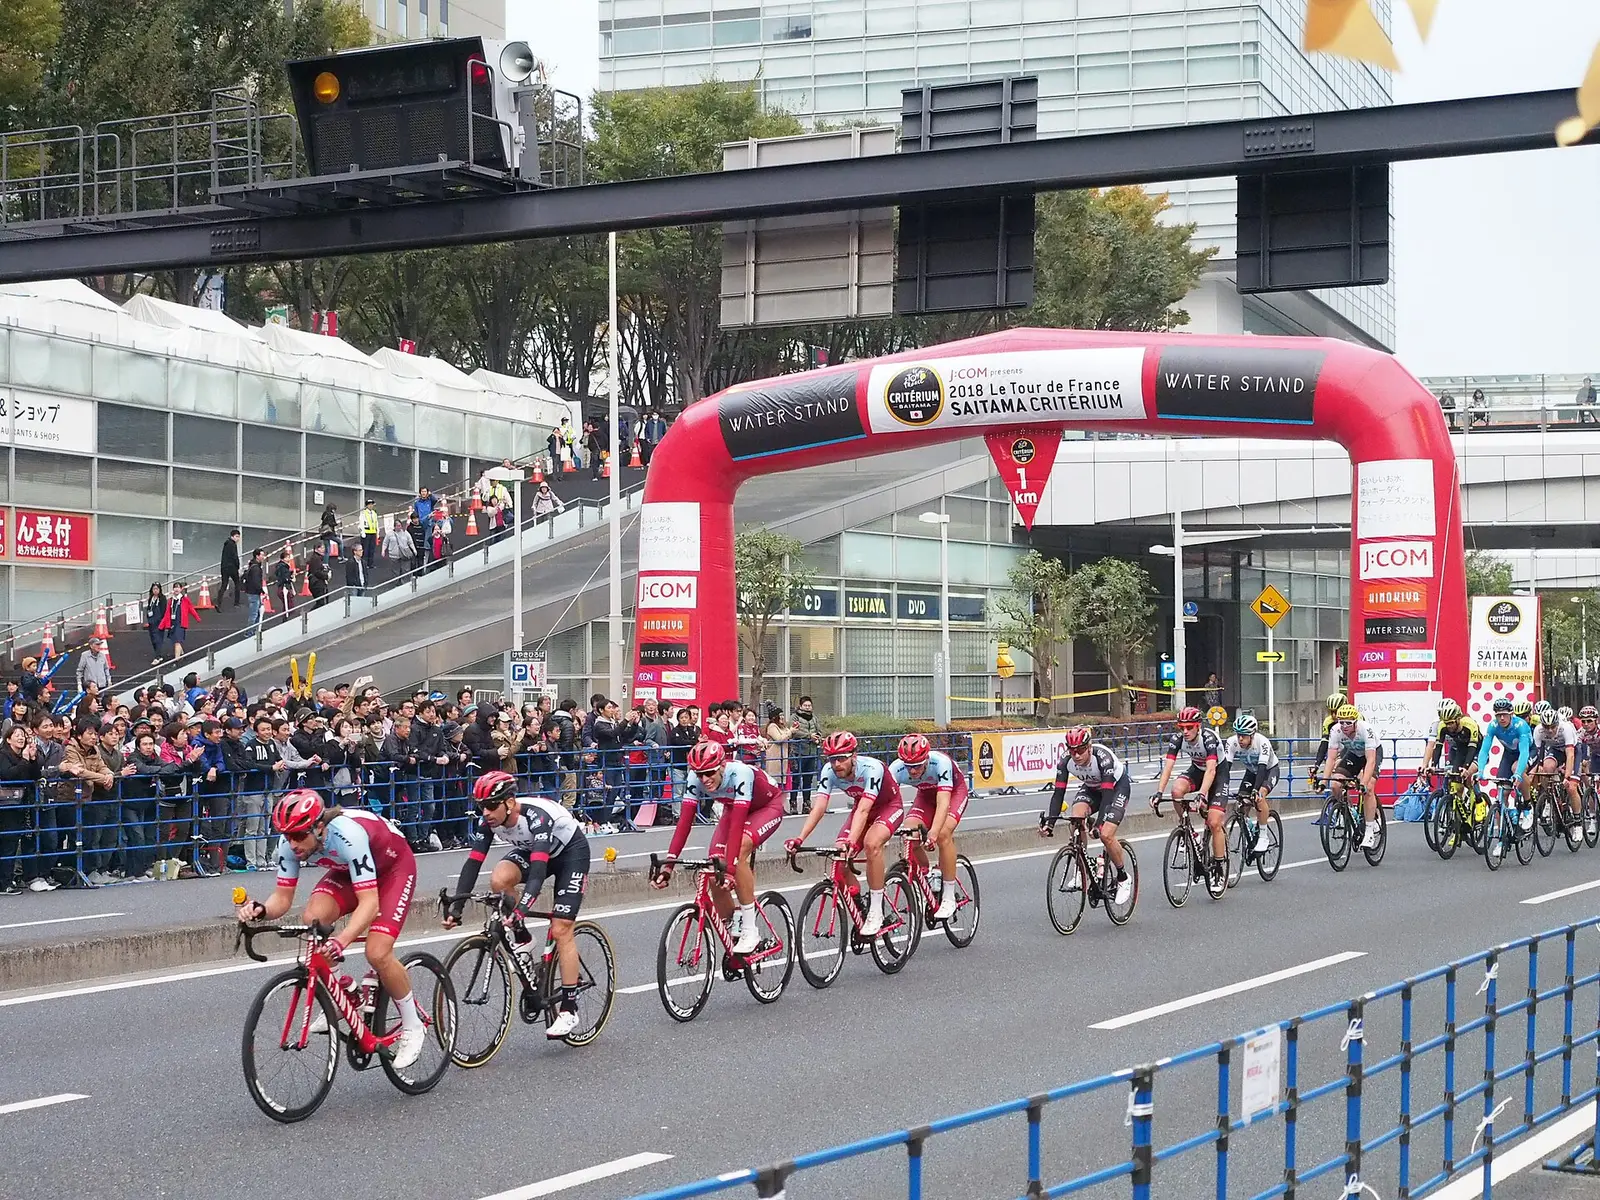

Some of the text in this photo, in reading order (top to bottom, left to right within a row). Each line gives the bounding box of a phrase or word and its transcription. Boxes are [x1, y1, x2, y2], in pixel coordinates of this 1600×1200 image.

[949, 367, 1023, 382] J:COM presents
[1165, 372, 1305, 393] WATER STAND
[889, 390, 940, 403] CRITÉRIUM
[949, 379, 1120, 398] 2018 Le Tour de France
[14, 400, 60, 423] ショップ
[951, 393, 1123, 416] SAITAMA CRITÉRIUM
[729, 397, 849, 432] WATER STAND
[40, 432, 60, 441] SHOPS
[1016, 468, 1027, 489] 1
[1015, 490, 1038, 504] km
[17, 515, 72, 546] ん受付
[1364, 549, 1427, 572] J:COM
[641, 583, 692, 602] J:COM
[848, 596, 887, 614] TSUTAYA
[908, 600, 926, 615] DVD
[1365, 626, 1425, 635] WATER STAND
[1477, 651, 1528, 660] SAITAMA
[1500, 674, 1533, 682] montagne
[1008, 745, 1027, 771] 4K
[1115, 793, 1127, 808] UAE
[757, 816, 781, 836] KATUSHA
[352, 854, 374, 877] K
[566, 872, 584, 894] UAE
[392, 874, 414, 922] KATUSHA
[520, 892, 532, 905] UAE
